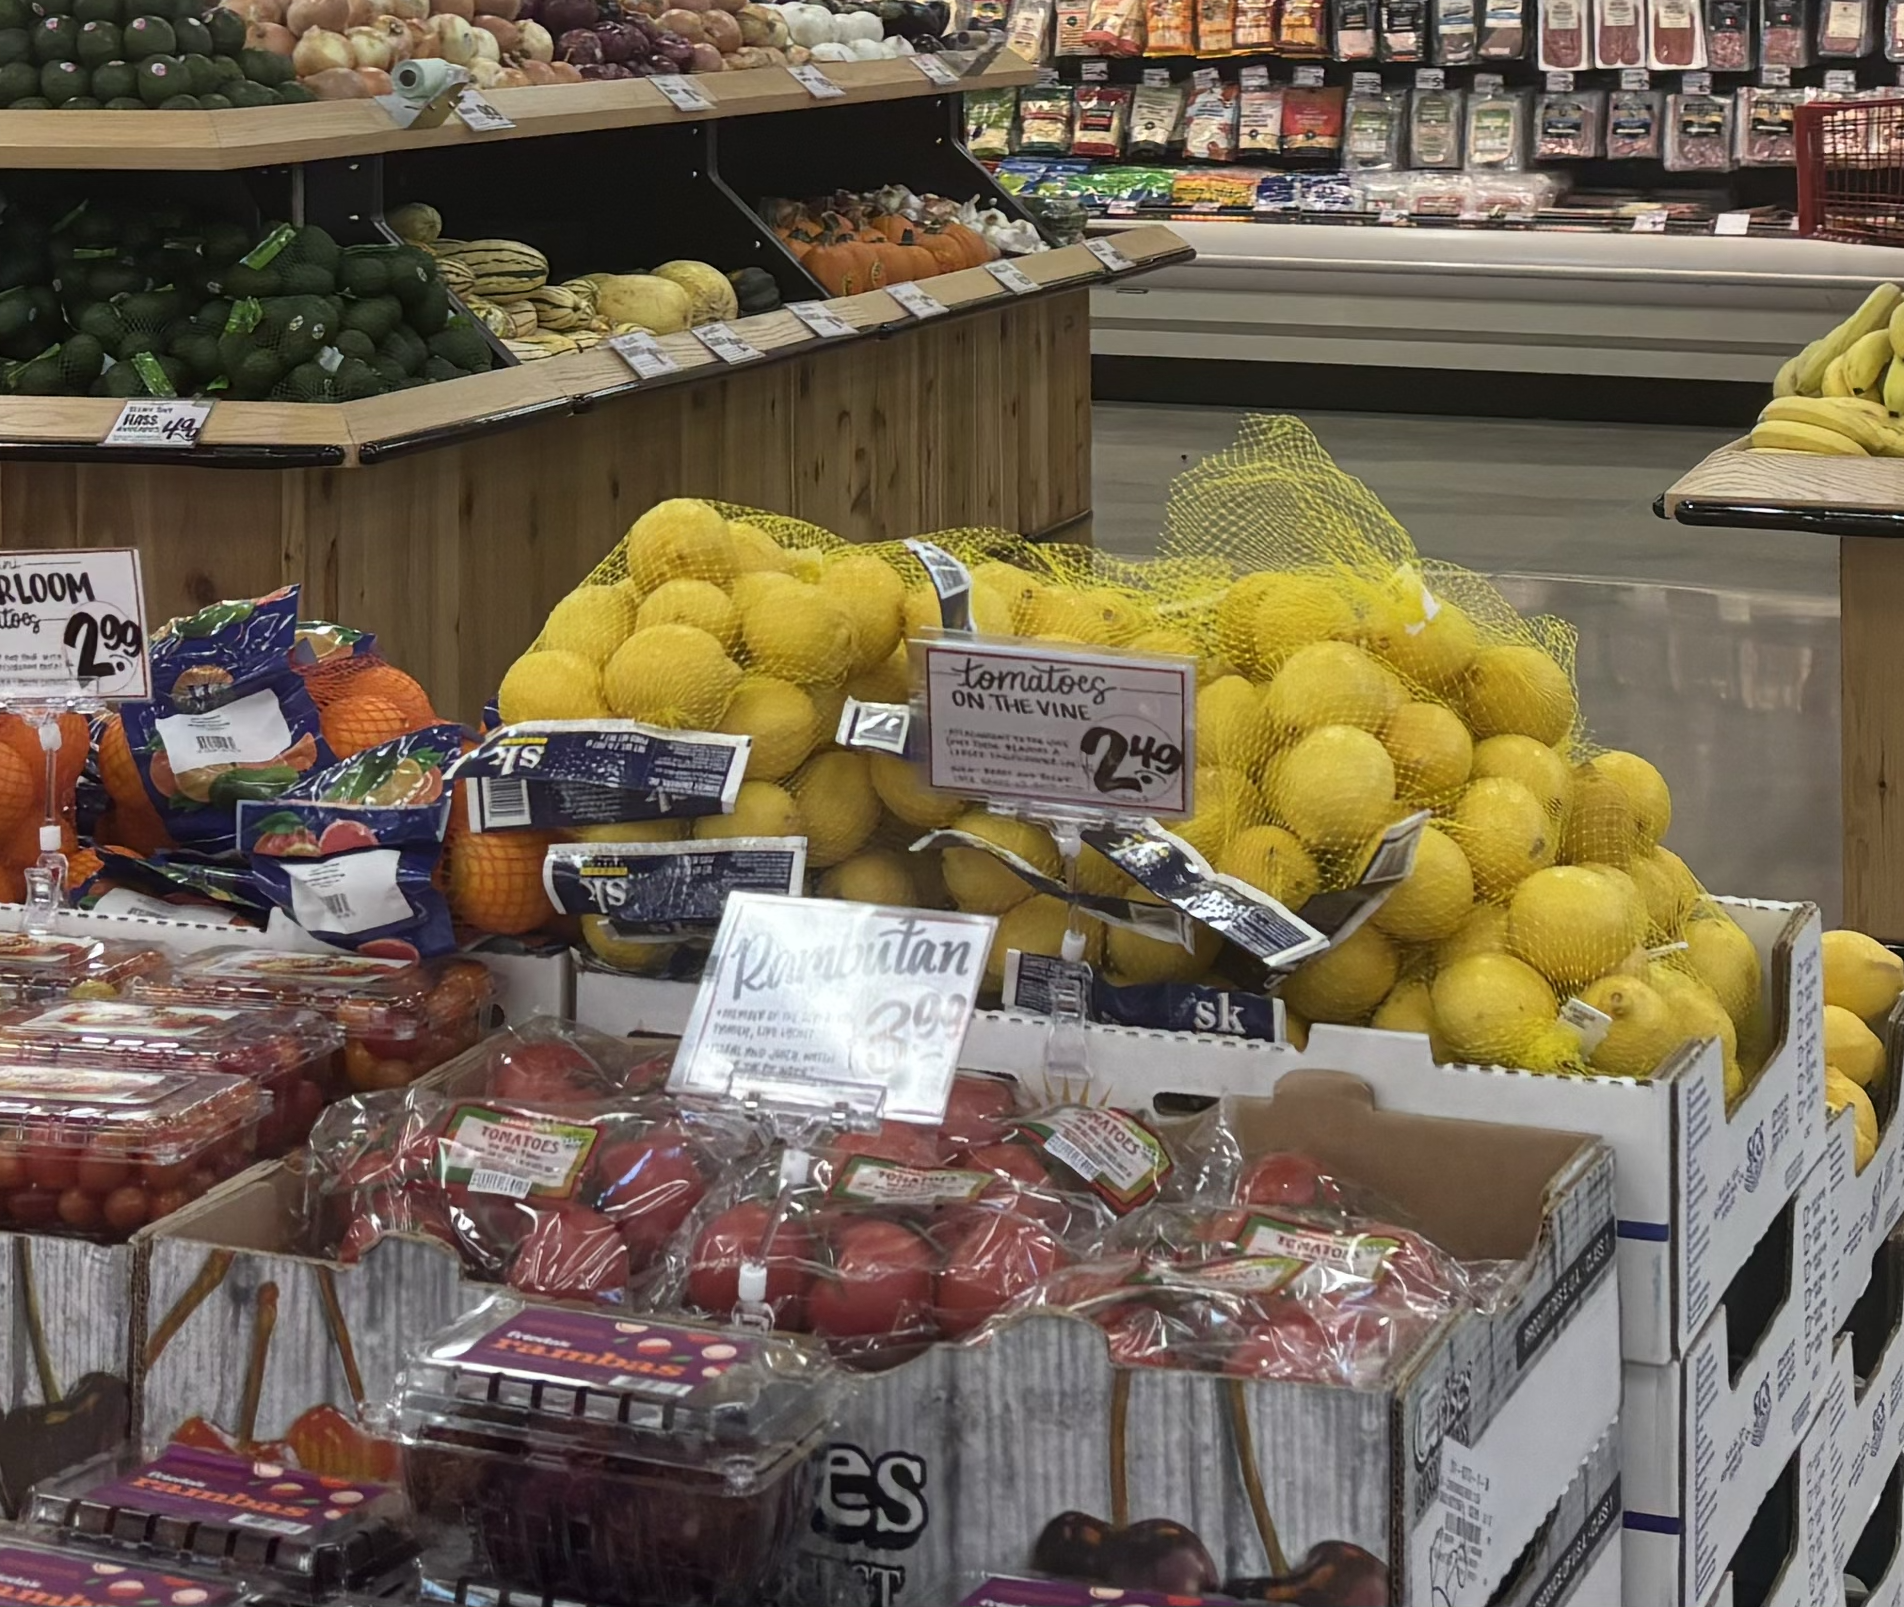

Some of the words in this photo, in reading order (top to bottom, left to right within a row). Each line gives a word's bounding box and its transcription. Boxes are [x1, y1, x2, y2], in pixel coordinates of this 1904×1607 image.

[123, 414, 158, 426] HASS
[63, 612, 143, 679] 2.99
[952, 658, 1112, 705] tomatoes
[952, 690, 985, 711] ON
[991, 694, 1034, 715] THE
[1037, 700, 1091, 721] VINE
[1080, 727, 1183, 793] 2.49
[730, 917, 972, 1001] Rambutan
[1194, 992, 1247, 1035] sk
[480, 1125, 560, 1155] TOMATOES
